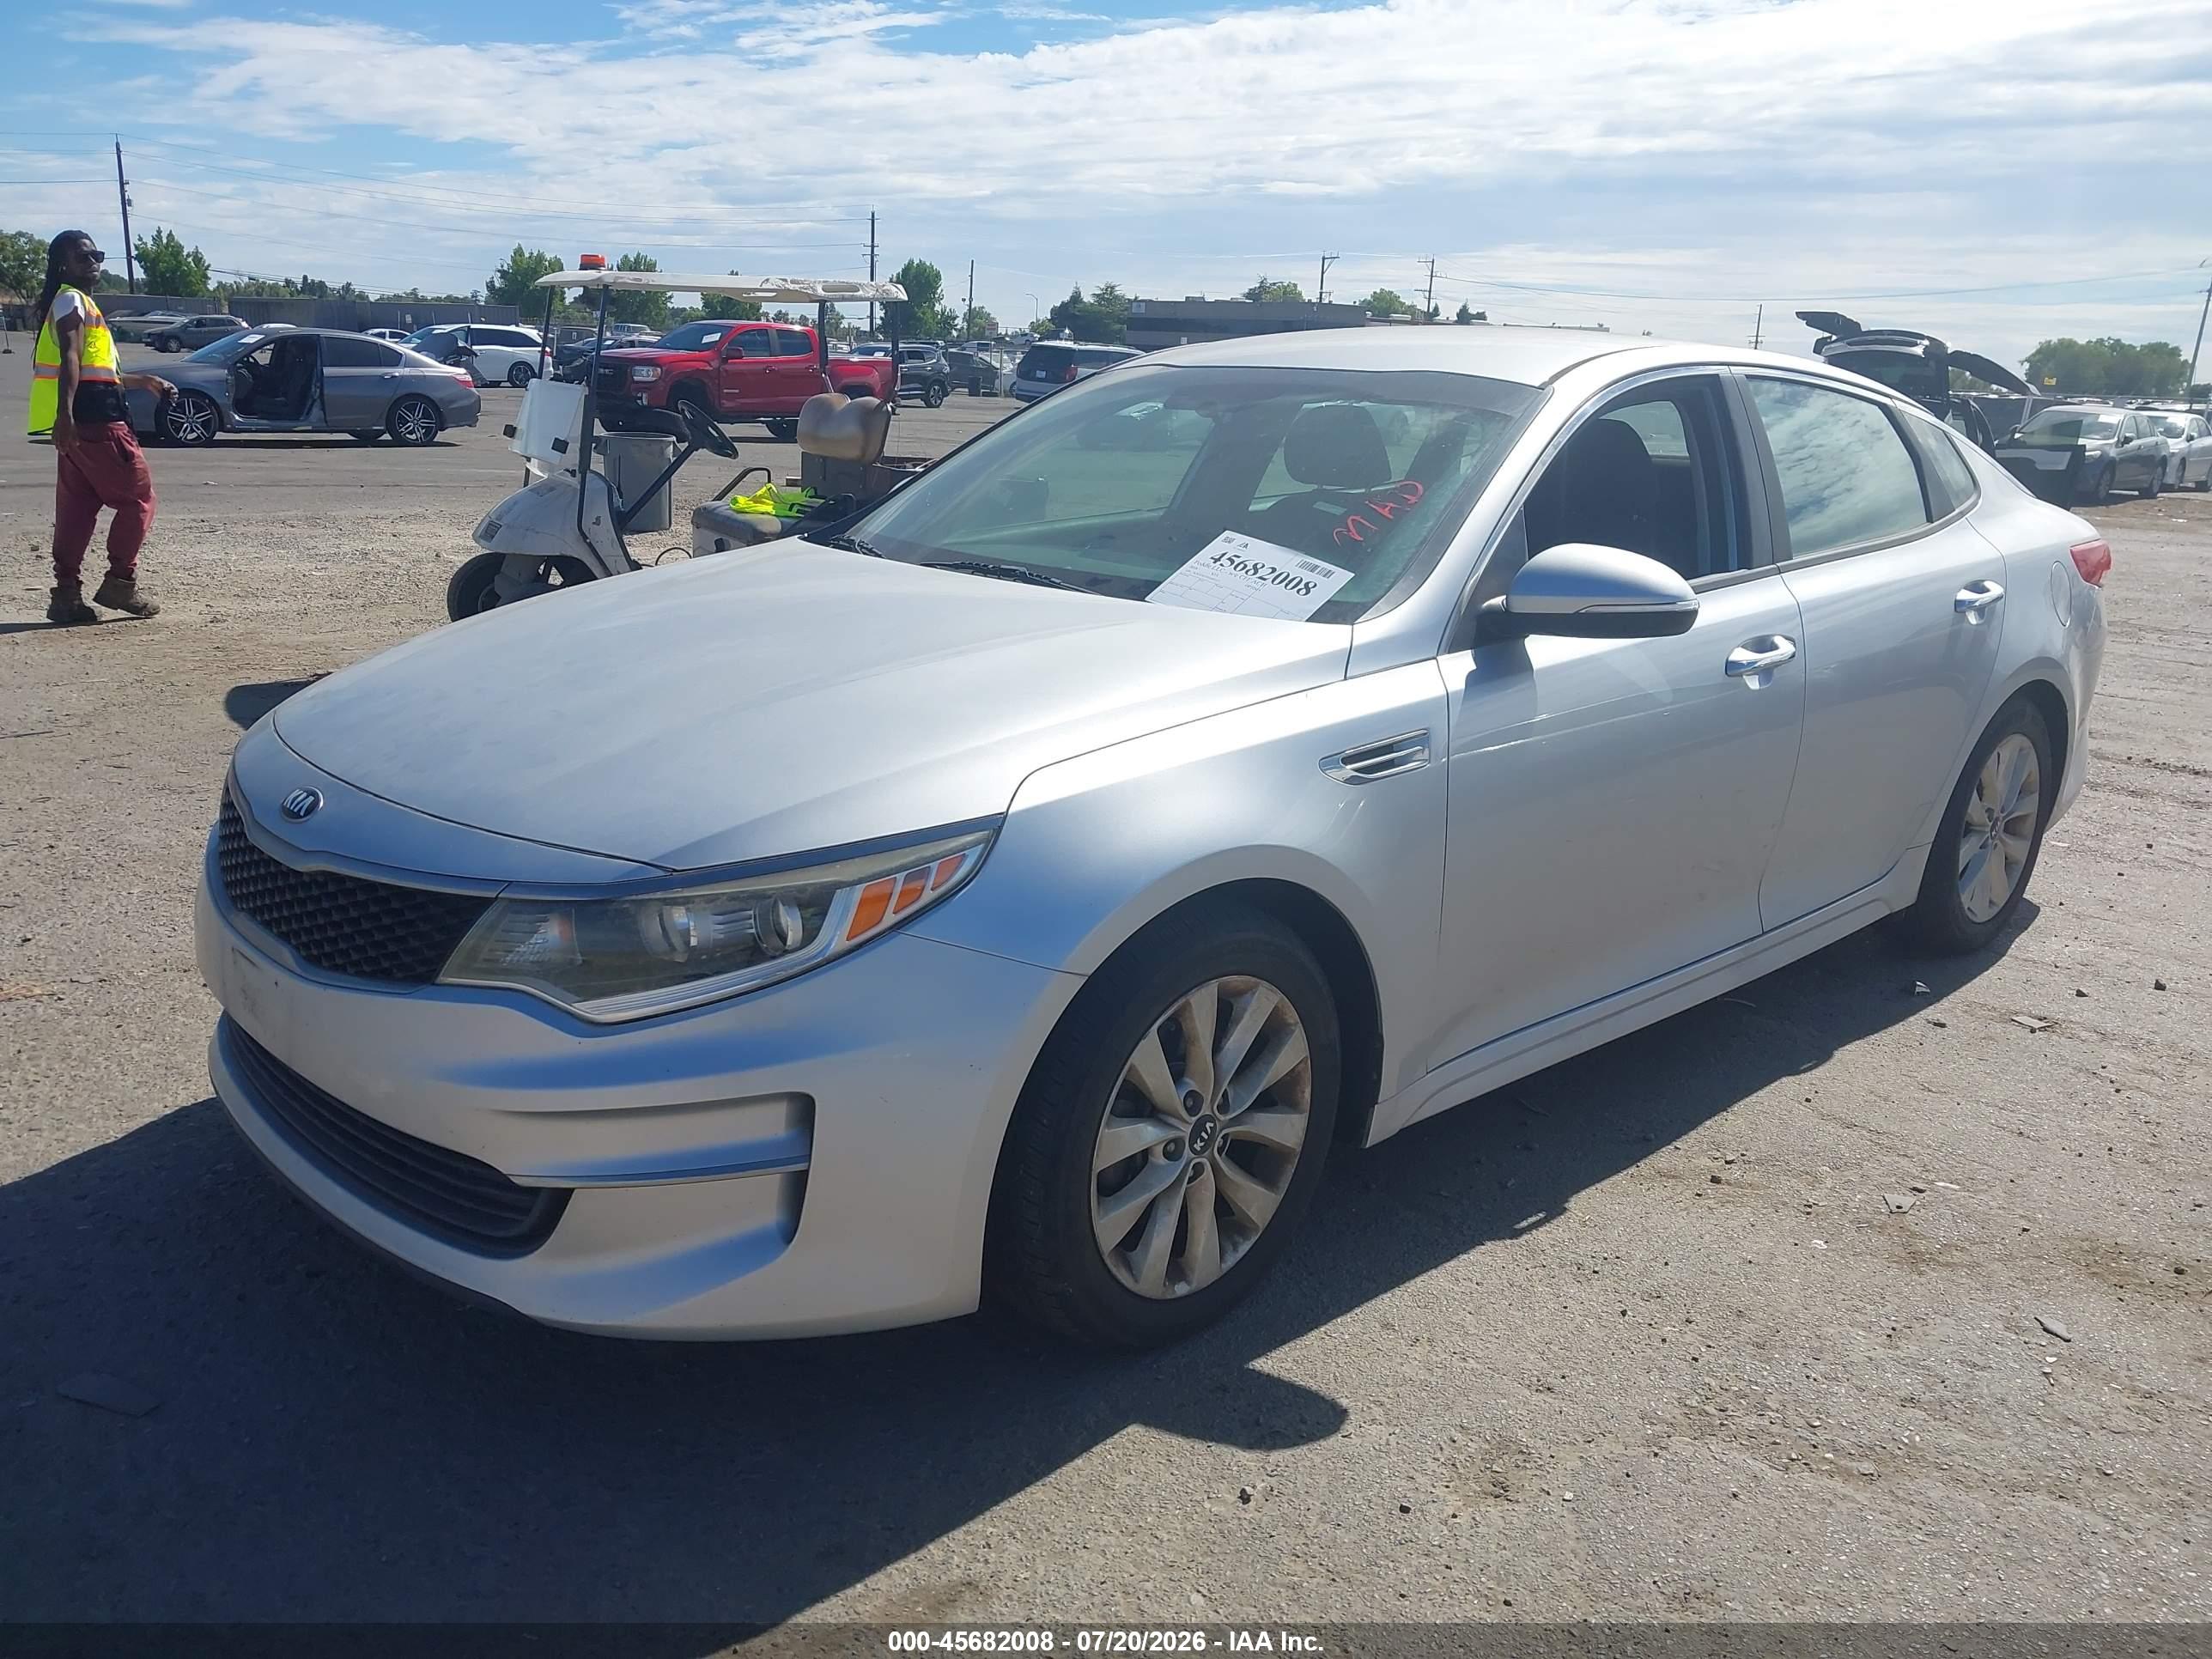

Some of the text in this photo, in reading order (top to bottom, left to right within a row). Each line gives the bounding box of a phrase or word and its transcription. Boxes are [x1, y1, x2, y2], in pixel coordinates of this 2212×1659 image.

[1209, 551, 1317, 596] 45682008
[283, 788, 315, 817] KIA
[1194, 1121, 1214, 1152] KIA
